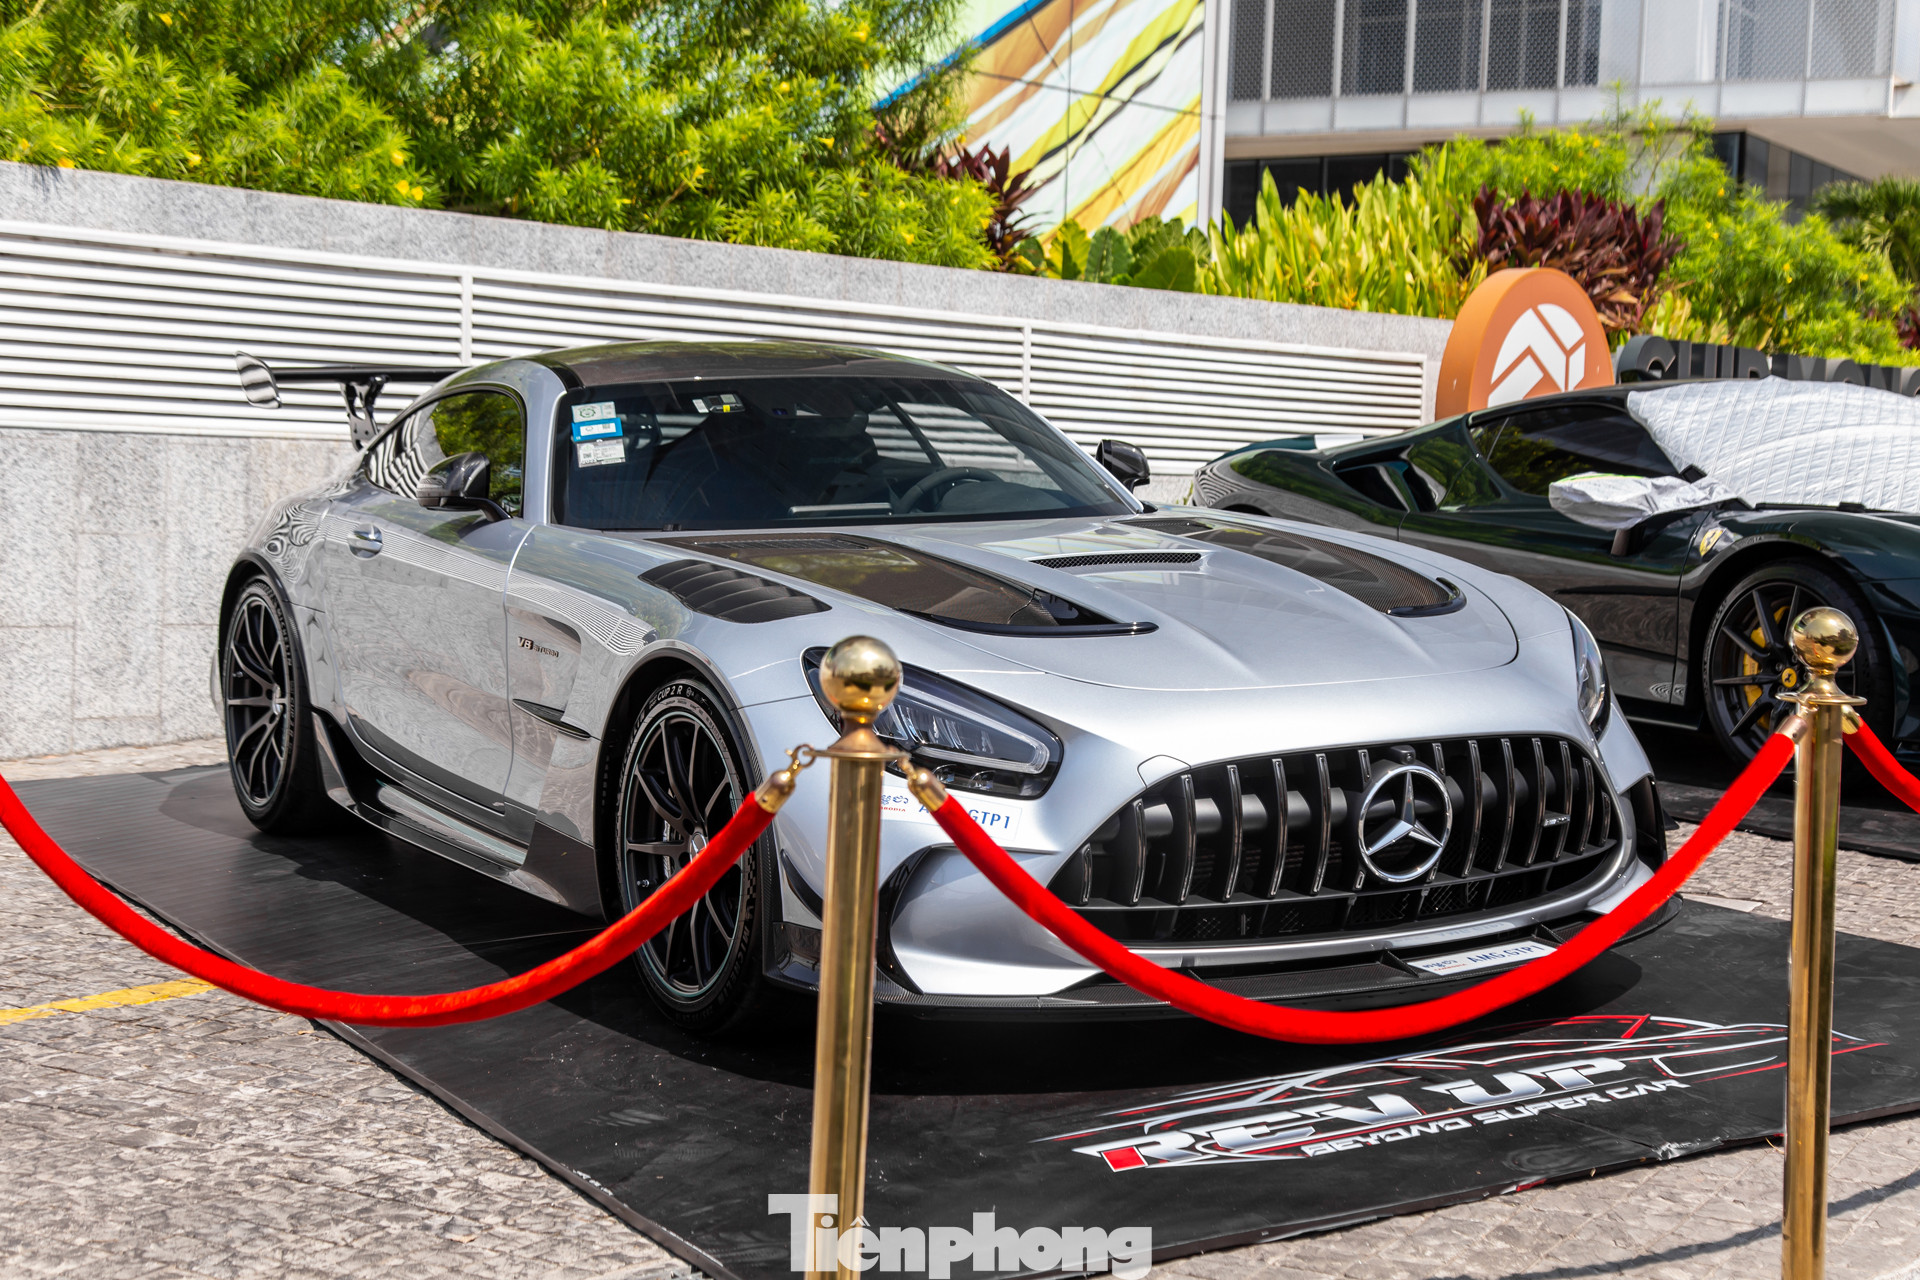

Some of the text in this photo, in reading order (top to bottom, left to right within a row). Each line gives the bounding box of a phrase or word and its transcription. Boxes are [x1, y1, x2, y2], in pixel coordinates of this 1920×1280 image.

[517, 636, 534, 650] V8
[657, 685, 683, 701] CUP 2 R
[1422, 1057, 1627, 1106] UP
[1300, 1079, 1691, 1157] BEYOND SUPER CAR
